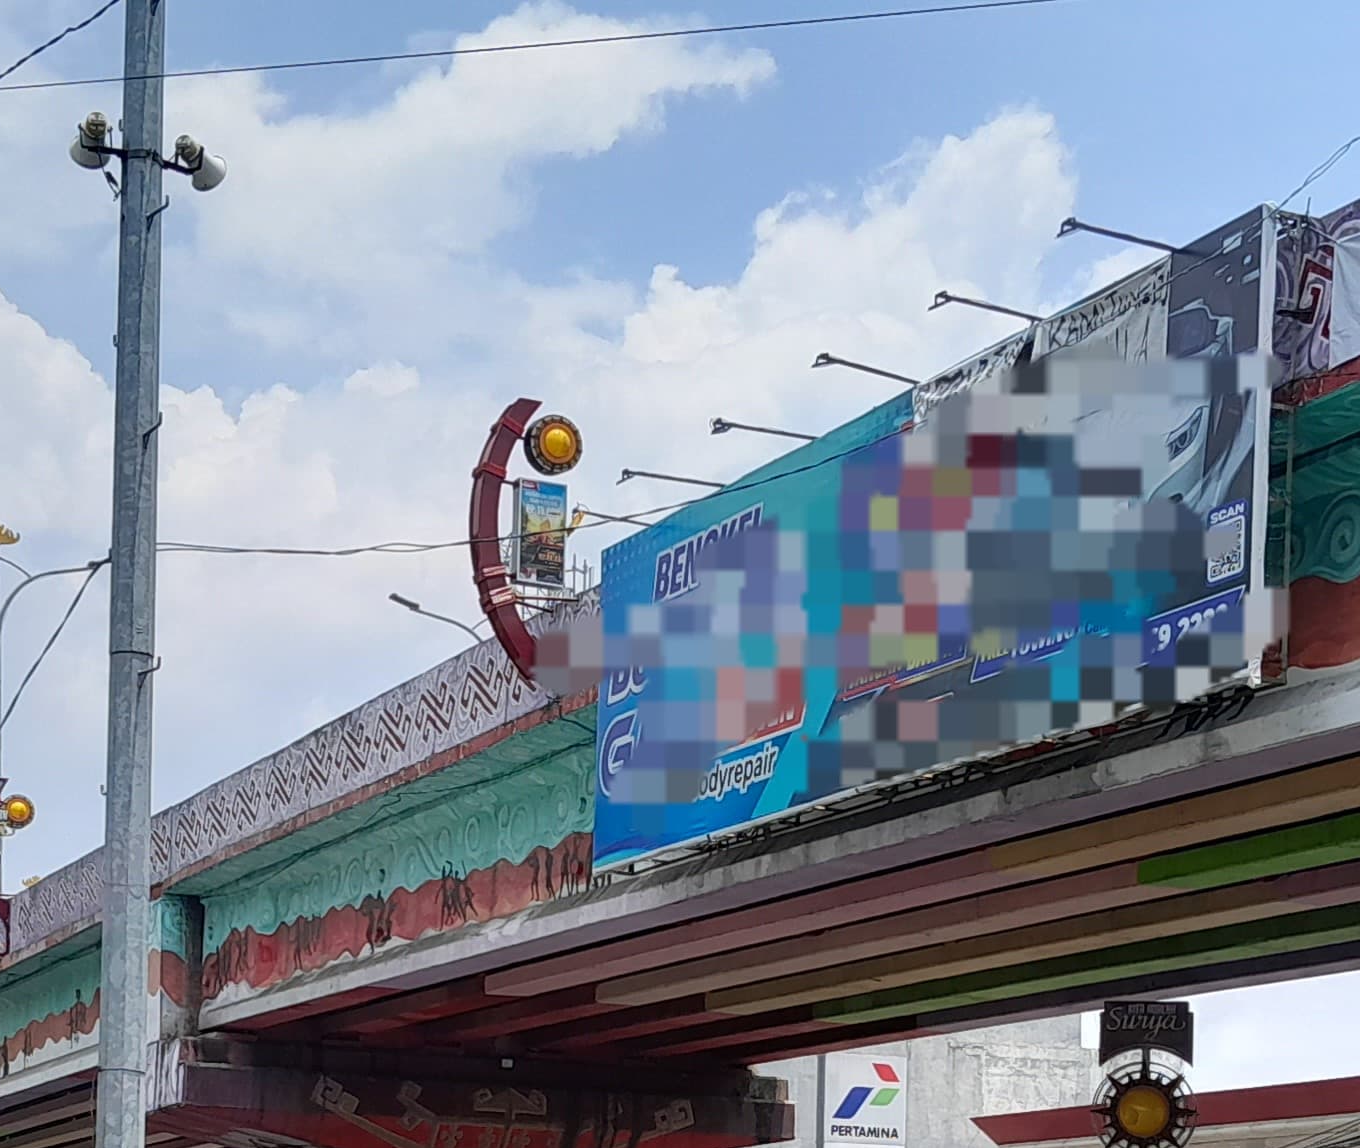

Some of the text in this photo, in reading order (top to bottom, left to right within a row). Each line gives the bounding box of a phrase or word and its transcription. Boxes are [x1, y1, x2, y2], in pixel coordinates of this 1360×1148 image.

[1210, 502, 1246, 525] SCAN
[1106, 1006, 1187, 1040] Surya
[830, 1124, 899, 1139] PERTAMINA
